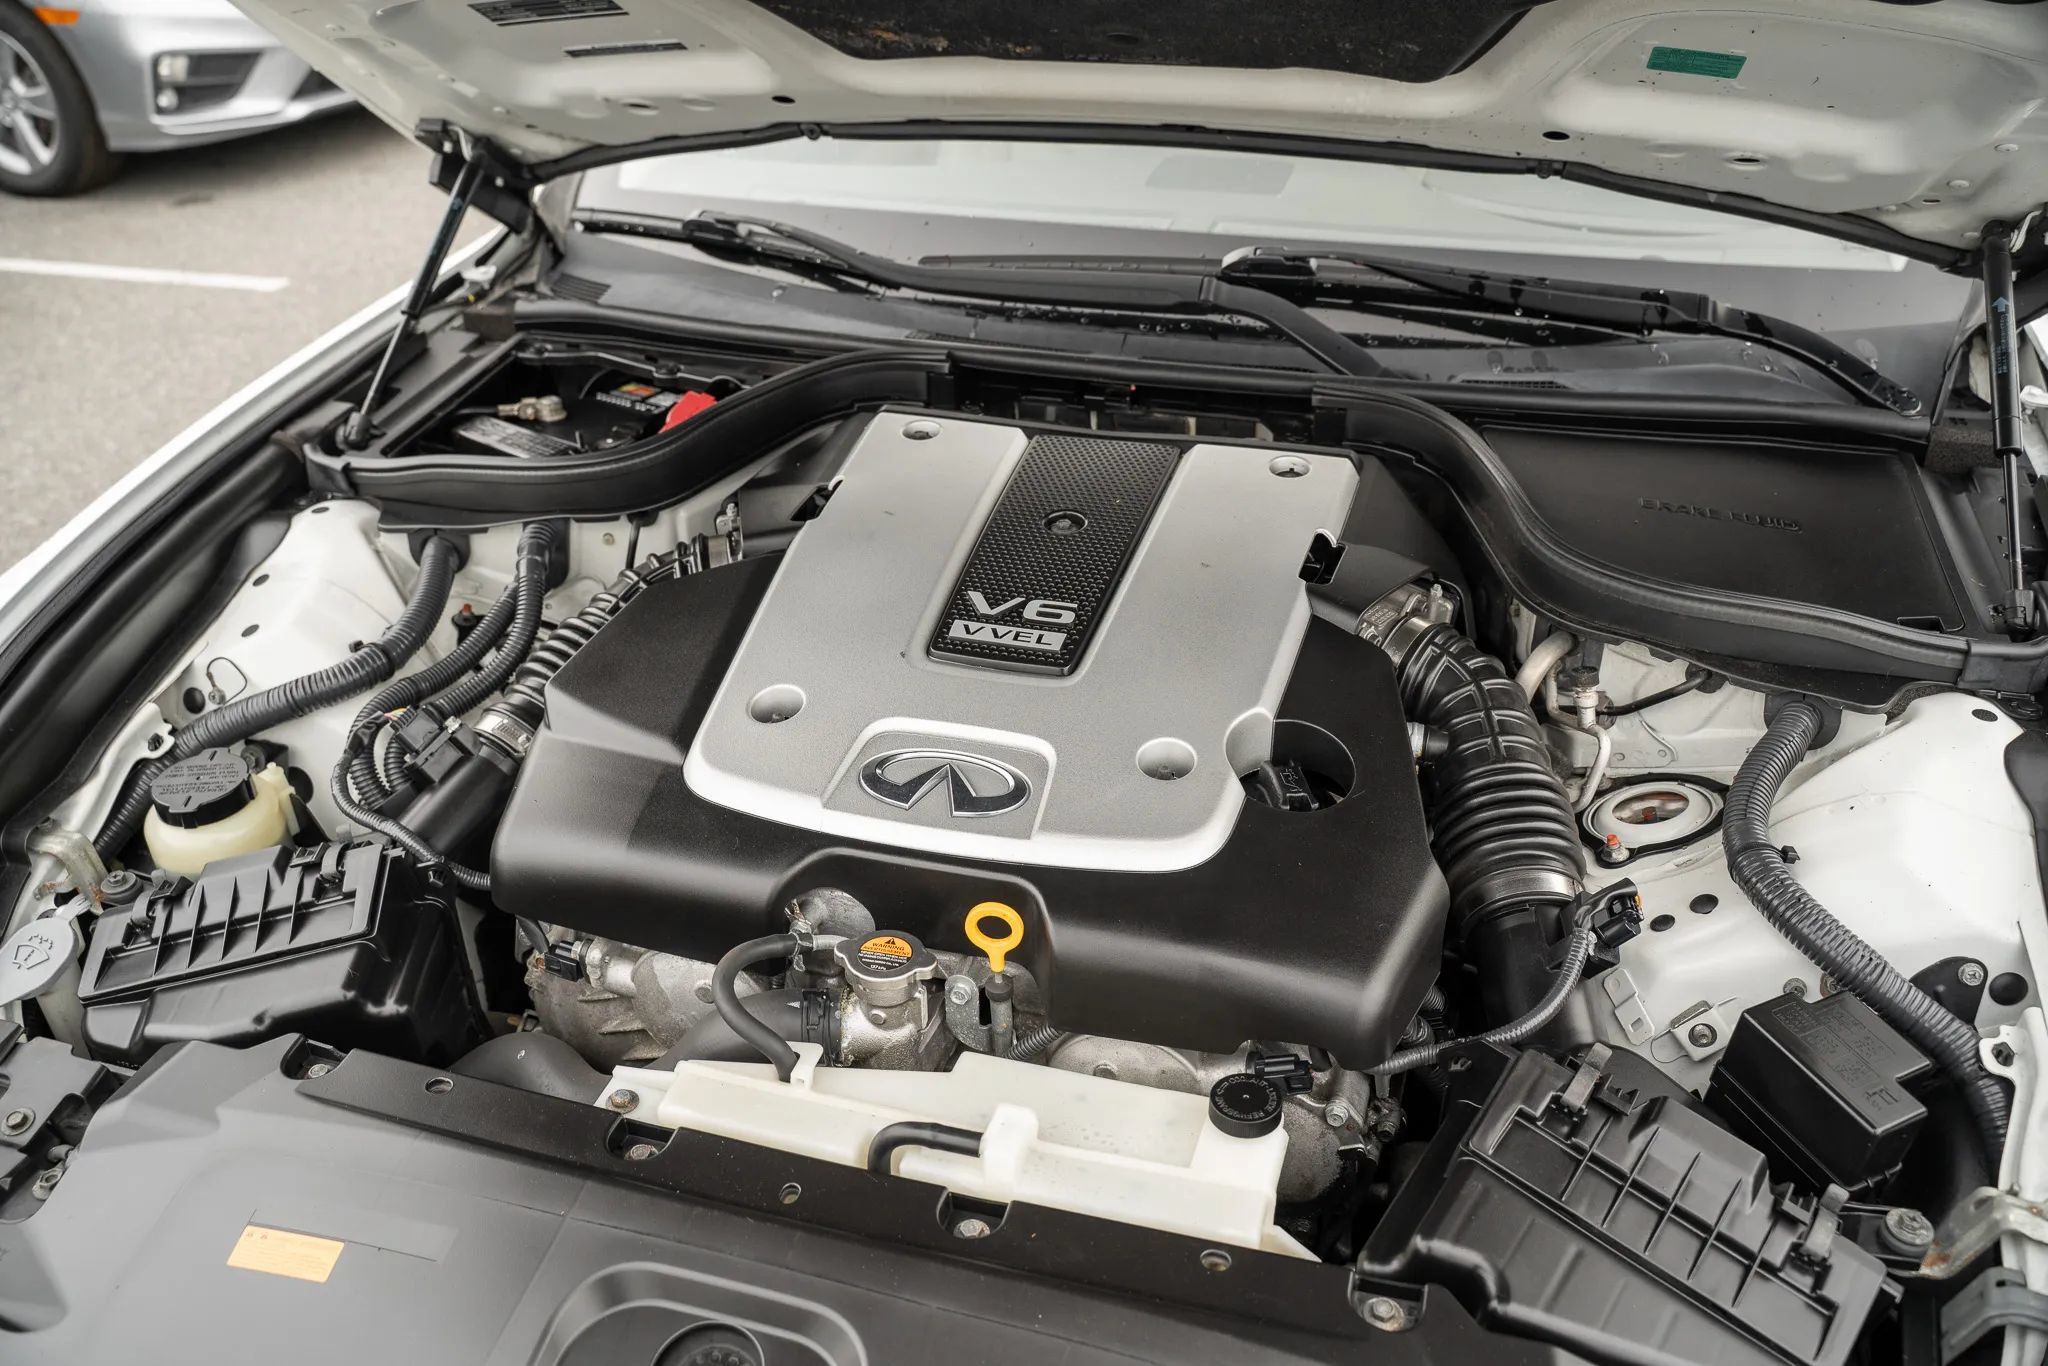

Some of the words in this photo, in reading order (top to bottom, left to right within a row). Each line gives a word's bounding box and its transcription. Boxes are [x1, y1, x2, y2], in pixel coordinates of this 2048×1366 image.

[1638, 496, 1722, 520] BRAKE
[1728, 511, 1803, 534] FLUID
[967, 590, 1078, 627] V6
[962, 622, 1054, 646] VVEL
[872, 943, 904, 951] WARNING
